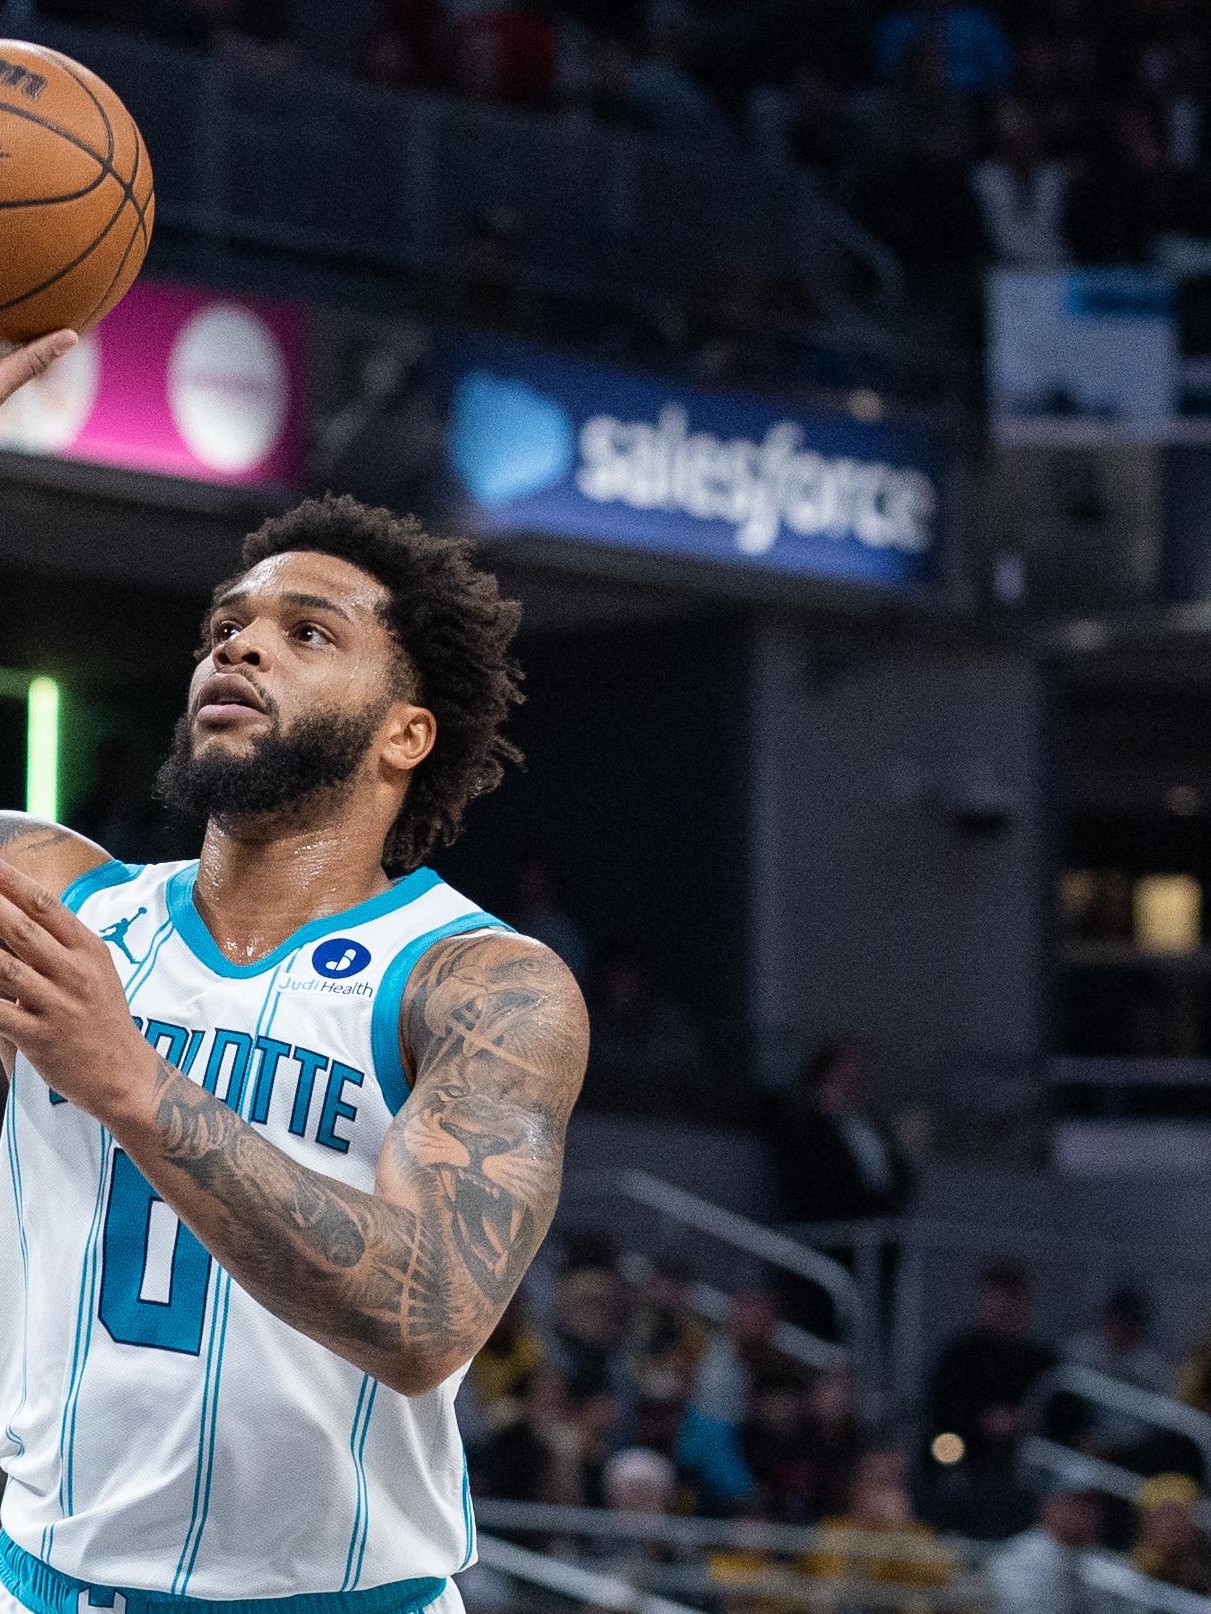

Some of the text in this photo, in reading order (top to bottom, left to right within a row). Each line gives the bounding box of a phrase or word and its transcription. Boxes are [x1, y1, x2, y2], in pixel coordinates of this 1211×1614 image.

[580, 402, 937, 554] salesforce
[278, 977, 374, 998] Judi Health
[98, 1147, 213, 1357] 0
